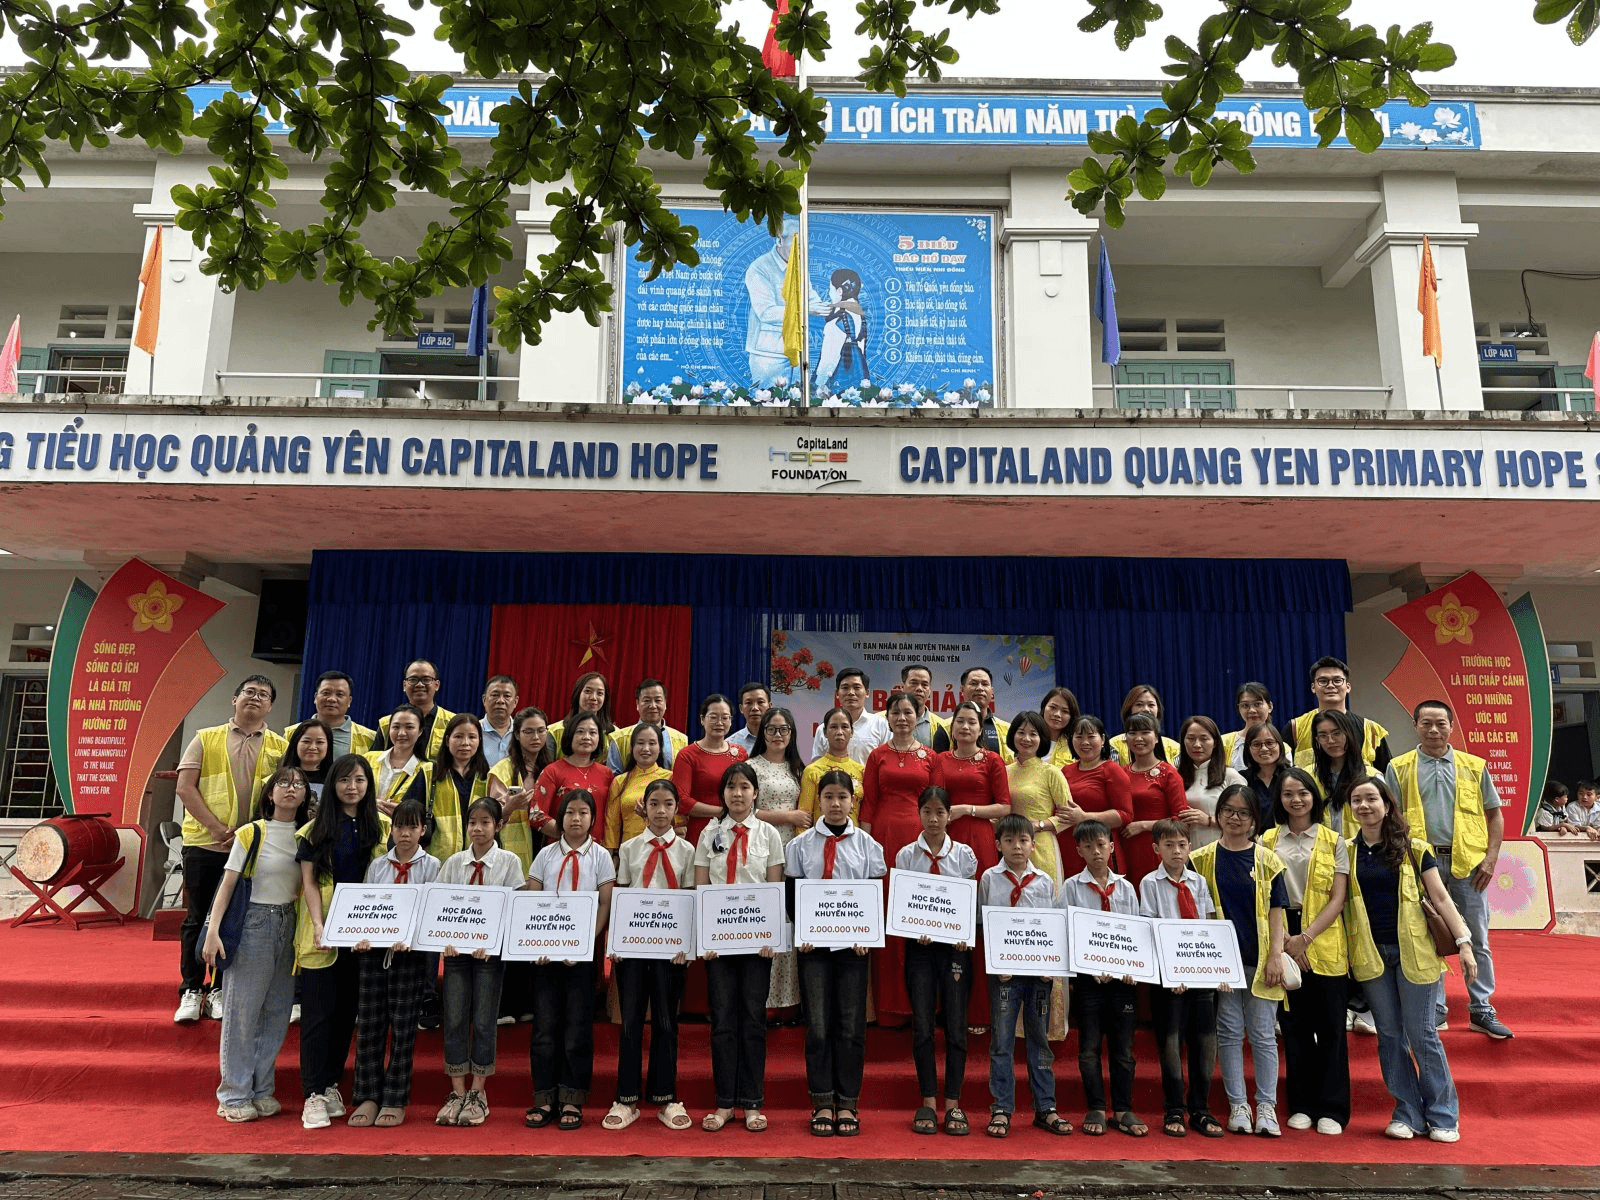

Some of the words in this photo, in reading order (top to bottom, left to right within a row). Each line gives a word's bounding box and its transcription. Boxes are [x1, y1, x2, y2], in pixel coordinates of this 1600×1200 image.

[841, 105, 881, 138] LỢI
[890, 102, 934, 133] ÍCH
[942, 102, 1017, 134] TRĂM
[1026, 103, 1087, 134] NĂM
[898, 235, 915, 250] 5
[437, 336, 452, 346] 5A2
[1499, 348, 1513, 358] 4A1
[26, 416, 101, 471] TIỂU
[109, 433, 181, 479] HỌC
[190, 423, 311, 477] QUẢNG
[322, 429, 390, 475] YÊN
[401, 437, 619, 478] CAPITALAND
[630, 442, 718, 480] HOPE
[797, 437, 848, 451] CapitaLand
[900, 445, 1112, 484] CAPITALAND
[1124, 446, 1242, 488] QUANG
[1250, 447, 1319, 485] YEN
[1328, 448, 1484, 486] PRIMARY
[1495, 449, 1588, 488] HOPE
[94, 640, 117, 654] SỐNG
[878, 641, 898, 651] NHÂN
[938, 643, 960, 652] THANH
[961, 644, 971, 652] BA
[907, 654, 921, 664] HỌC
[1460, 653, 1493, 667] TRƯỜNG
[1494, 656, 1511, 670] HỌC
[86, 657, 110, 673] SỐNG
[111, 659, 123, 673] CÓ
[124, 659, 140, 673] ÍCH
[1450, 672, 1461, 686] LÀ
[1462, 673, 1477, 686] NƠI
[1502, 672, 1525, 686] CÁNH
[88, 678, 99, 692] LÀ
[101, 678, 115, 692] GIÁ
[118, 680, 131, 695] TRỊ
[1466, 693, 1482, 705] CHO
[1484, 691, 1513, 705] NHỮNG
[72, 697, 86, 711] MÀ
[88, 697, 106, 711] NHÀ
[109, 697, 142, 711] TRƯỜNG
[1475, 710, 1492, 724] ƯỚC
[1493, 711, 1508, 724] MƠ
[114, 716, 128, 731] TỚI
[1468, 728, 1485, 743] CỦA
[1486, 729, 1503, 743] CÁC
[1505, 731, 1519, 743] EM
[78, 736, 94, 745] LIVING
[74, 748, 91, 757] LIVING
[91, 748, 127, 757] MEANINGFULLY
[1489, 749, 1508, 758] SCHOOL
[83, 761, 89, 769] IS
[89, 761, 99, 769] THE
[100, 761, 115, 770] VALUE
[1487, 761, 1493, 770] IS
[1497, 762, 1512, 770] PLACE
[76, 773, 88, 782] THAT
[89, 773, 98, 782] THE
[99, 774, 118, 782] SCHOOL
[80, 786, 99, 795] STRIVES
[1505, 786, 1516, 795] TAKE
[912, 894, 928, 902] HỌC
[353, 904, 370, 912] HỌC
[818, 902, 835, 910] HỌC
[720, 908, 737, 916] HỌC
[847, 910, 864, 919] HỌC
[940, 907, 956, 915] HỌC
[530, 914, 547, 923] HỌC
[633, 912, 650, 920] HỌC
[749, 916, 766, 924] HỌC
[469, 917, 486, 925] HỌC
[901, 915, 942, 928] 2.000.000
[559, 924, 576, 932] HỌC
[661, 922, 678, 930] HỌC
[809, 925, 850, 933] 2.000.000
[427, 930, 469, 939] 2.000.000
[711, 932, 753, 941] 2.000.000
[1092, 931, 1108, 939] HỌC
[518, 939, 560, 947] 2.000.000
[622, 936, 663, 944] 2.000.000
[1121, 944, 1138, 952] HỌC
[1177, 942, 1194, 950] HỌC
[1000, 953, 1041, 962] 2.000.000
[1083, 953, 1125, 966] 2.000.000
[1207, 951, 1222, 959] HỌC
[1173, 966, 1212, 974] 2.000.000
